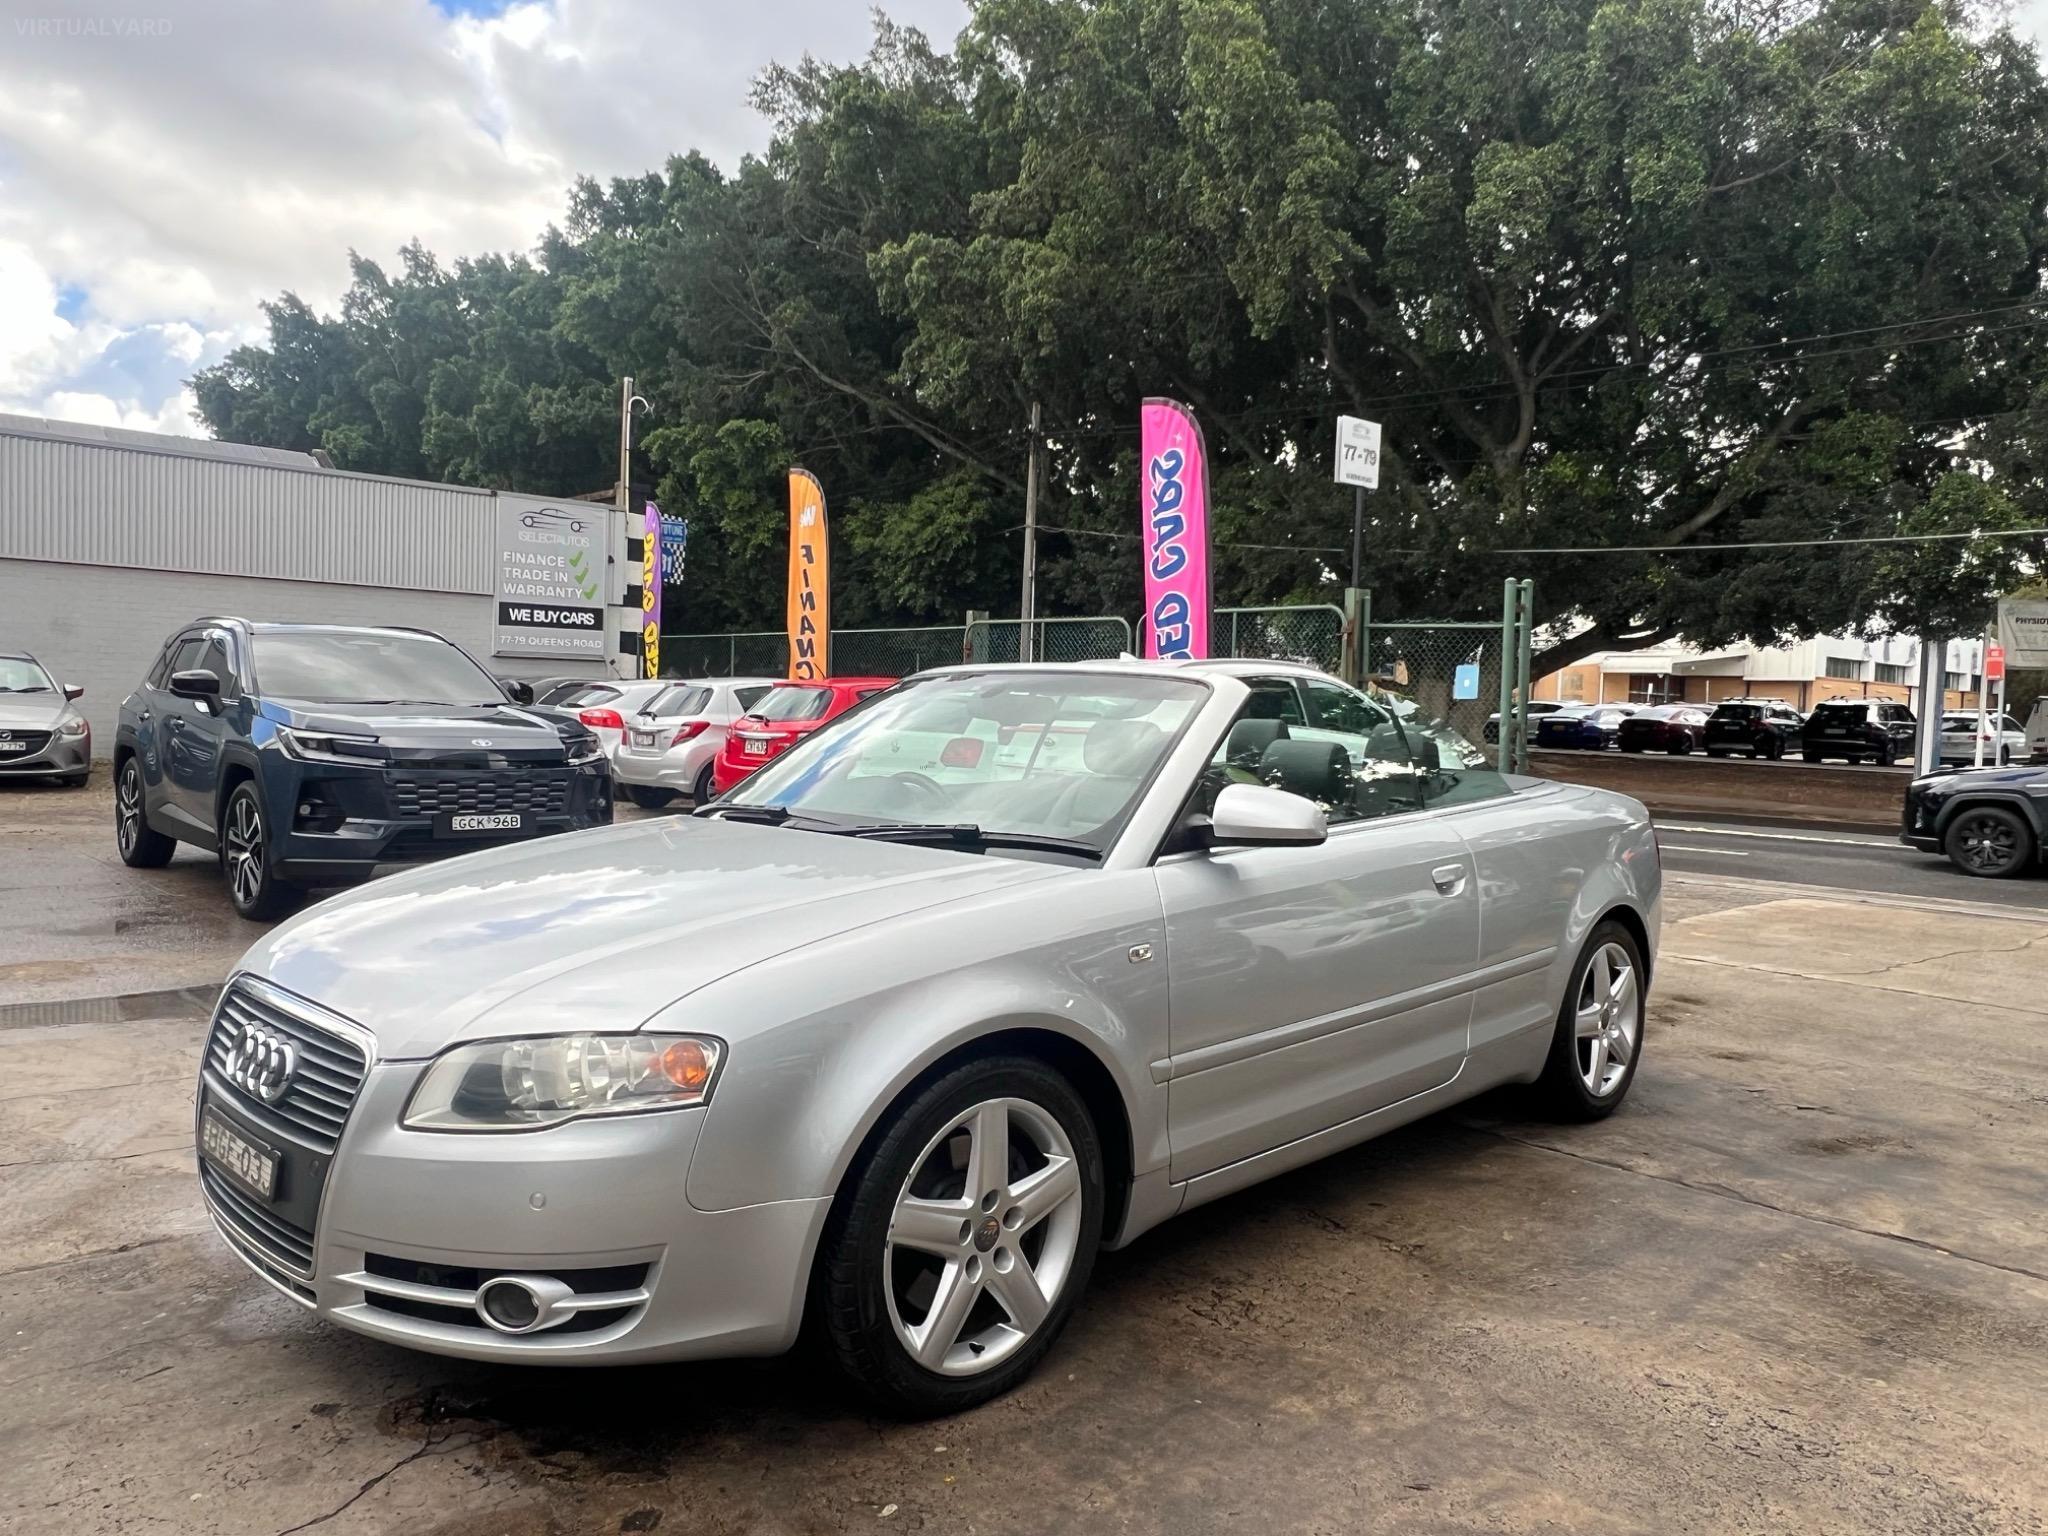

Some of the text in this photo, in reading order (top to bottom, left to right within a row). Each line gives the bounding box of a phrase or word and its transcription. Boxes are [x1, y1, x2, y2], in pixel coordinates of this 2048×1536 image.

[503, 551, 565, 567] FINANCE
[503, 567, 568, 582] TRADE IN
[503, 582, 583, 599] WARRANTY
[508, 608, 595, 625] WE BUY CARS
[500, 635, 602, 649] 77-79 QUEENS ROAD
